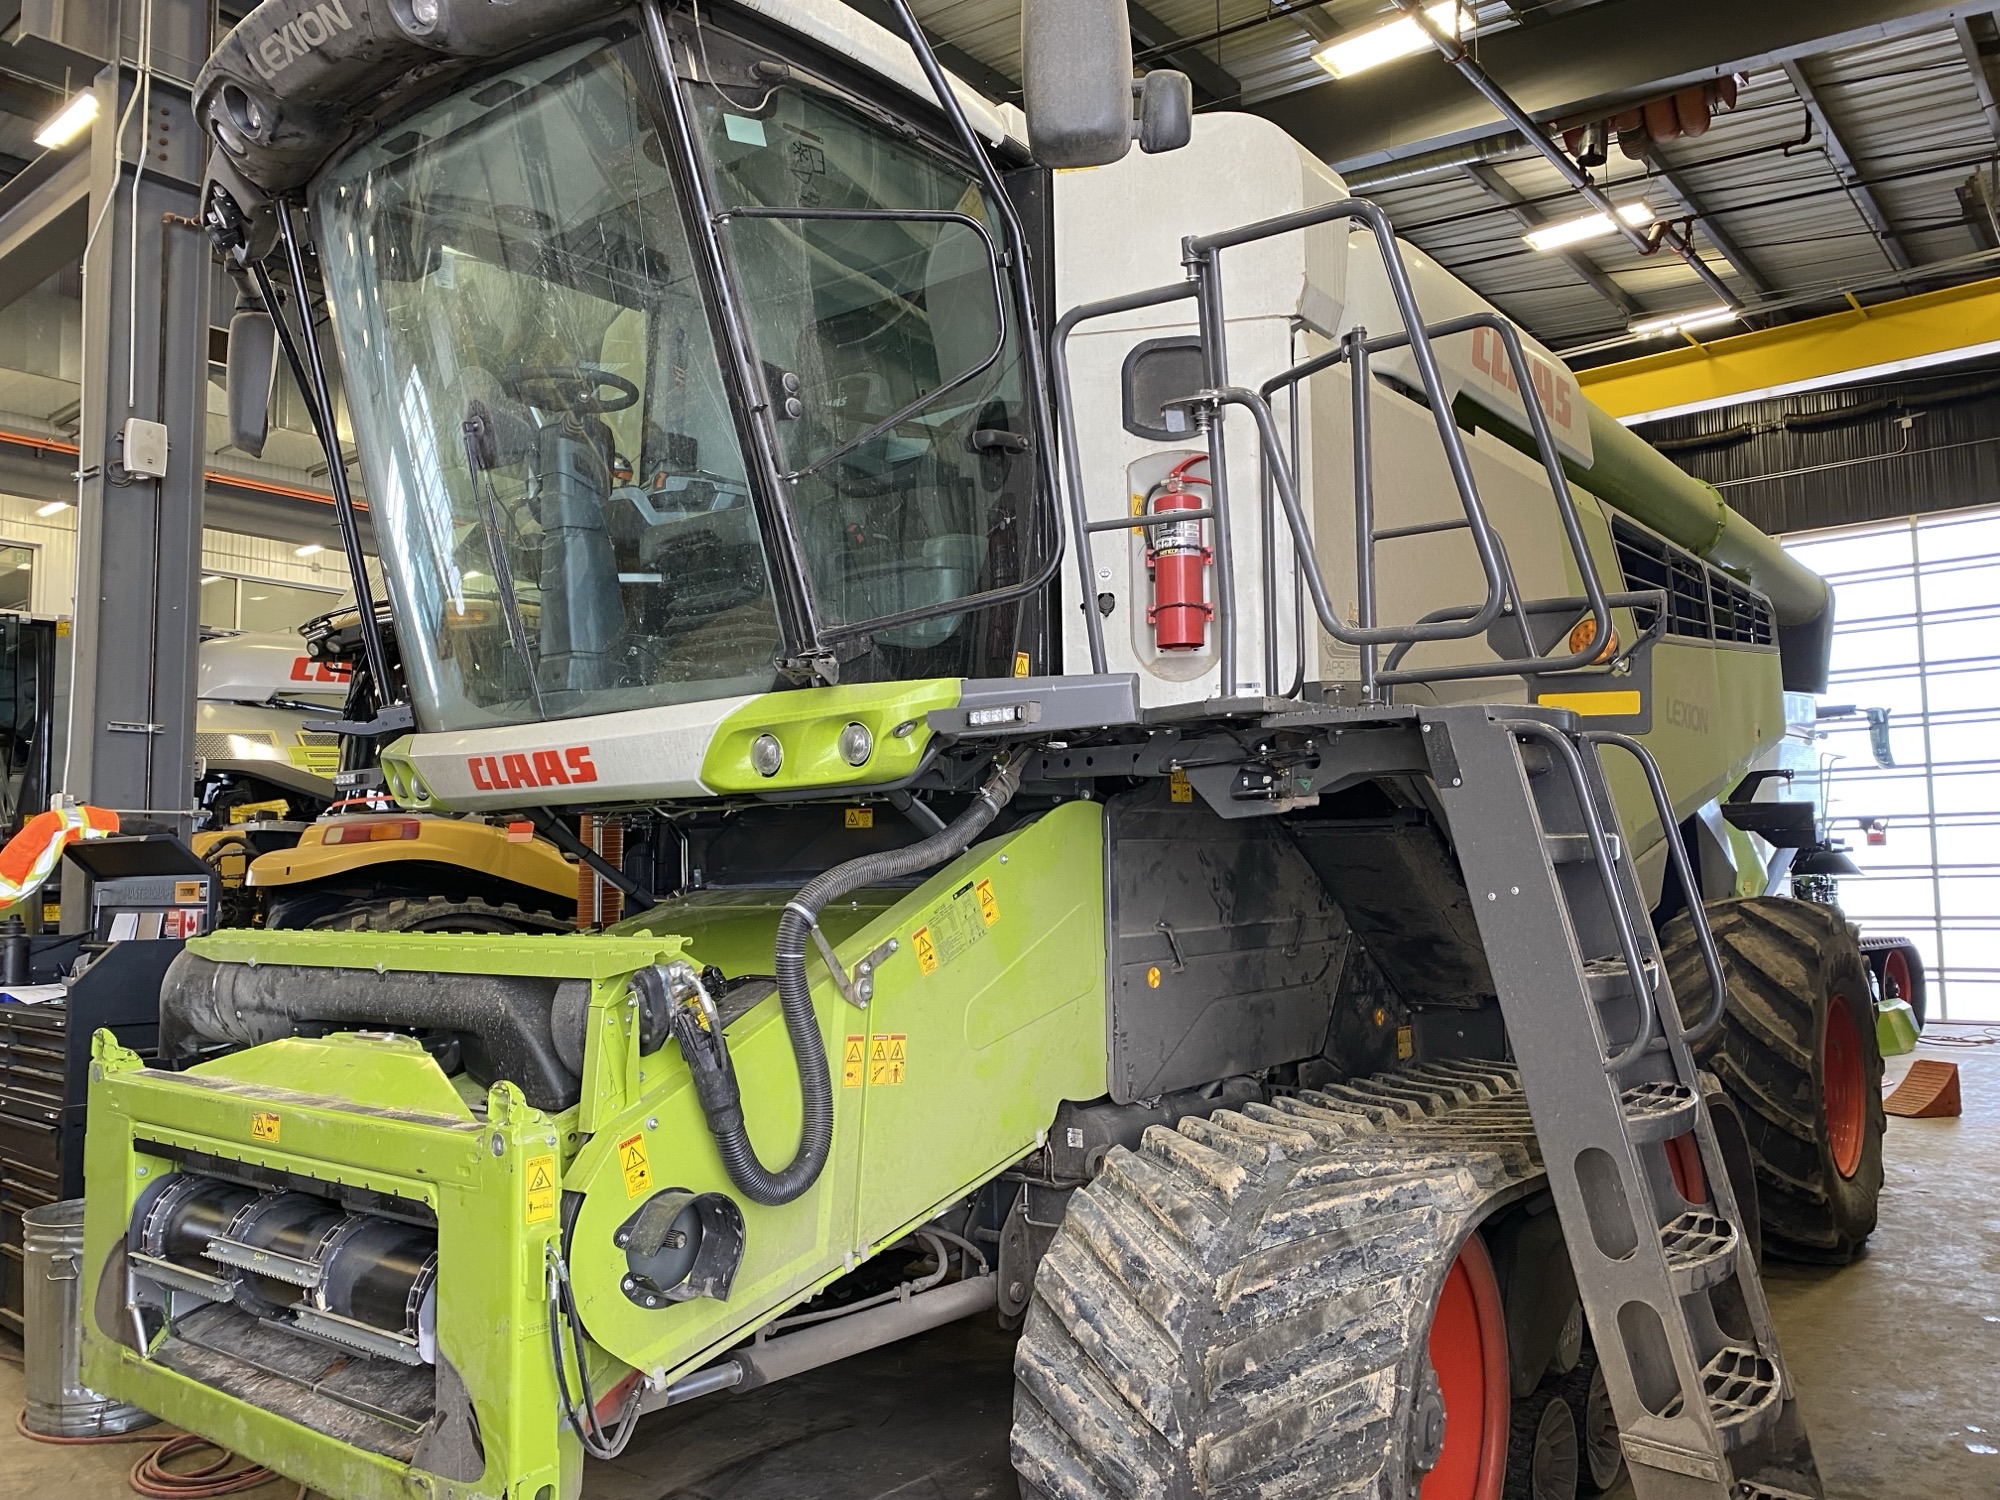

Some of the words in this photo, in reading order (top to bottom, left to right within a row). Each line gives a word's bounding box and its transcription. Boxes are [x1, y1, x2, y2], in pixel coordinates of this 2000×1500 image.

[247, 0, 353, 80] LEXION
[1666, 697, 1709, 735] LEXION
[467, 746, 598, 791] CLAAS
